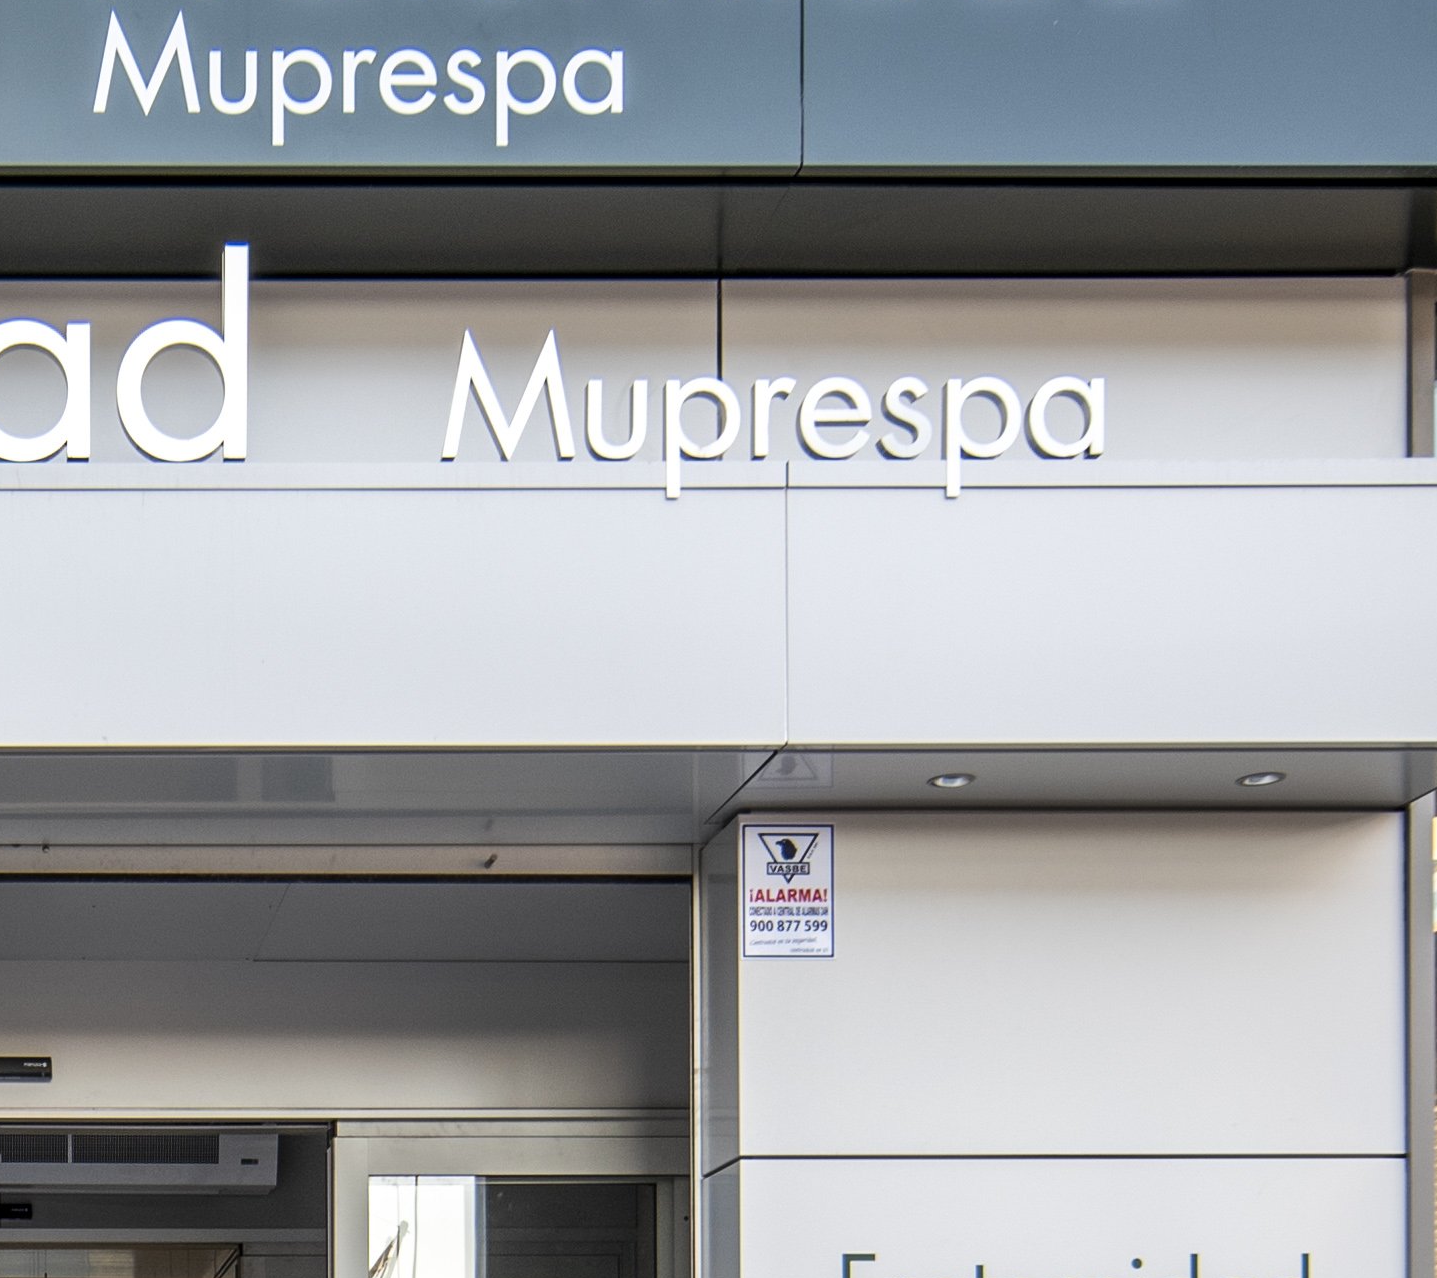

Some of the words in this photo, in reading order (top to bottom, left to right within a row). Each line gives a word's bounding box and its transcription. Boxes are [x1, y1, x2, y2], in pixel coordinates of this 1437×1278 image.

[92, 11, 625, 147] Muprespa
[439, 327, 1106, 500] Muprespa
[769, 864, 808, 874] VASBE
[749, 888, 828, 903] ¡ALARMA!
[749, 919, 774, 932] 900
[776, 919, 801, 932] 877
[804, 919, 828, 932] 599
